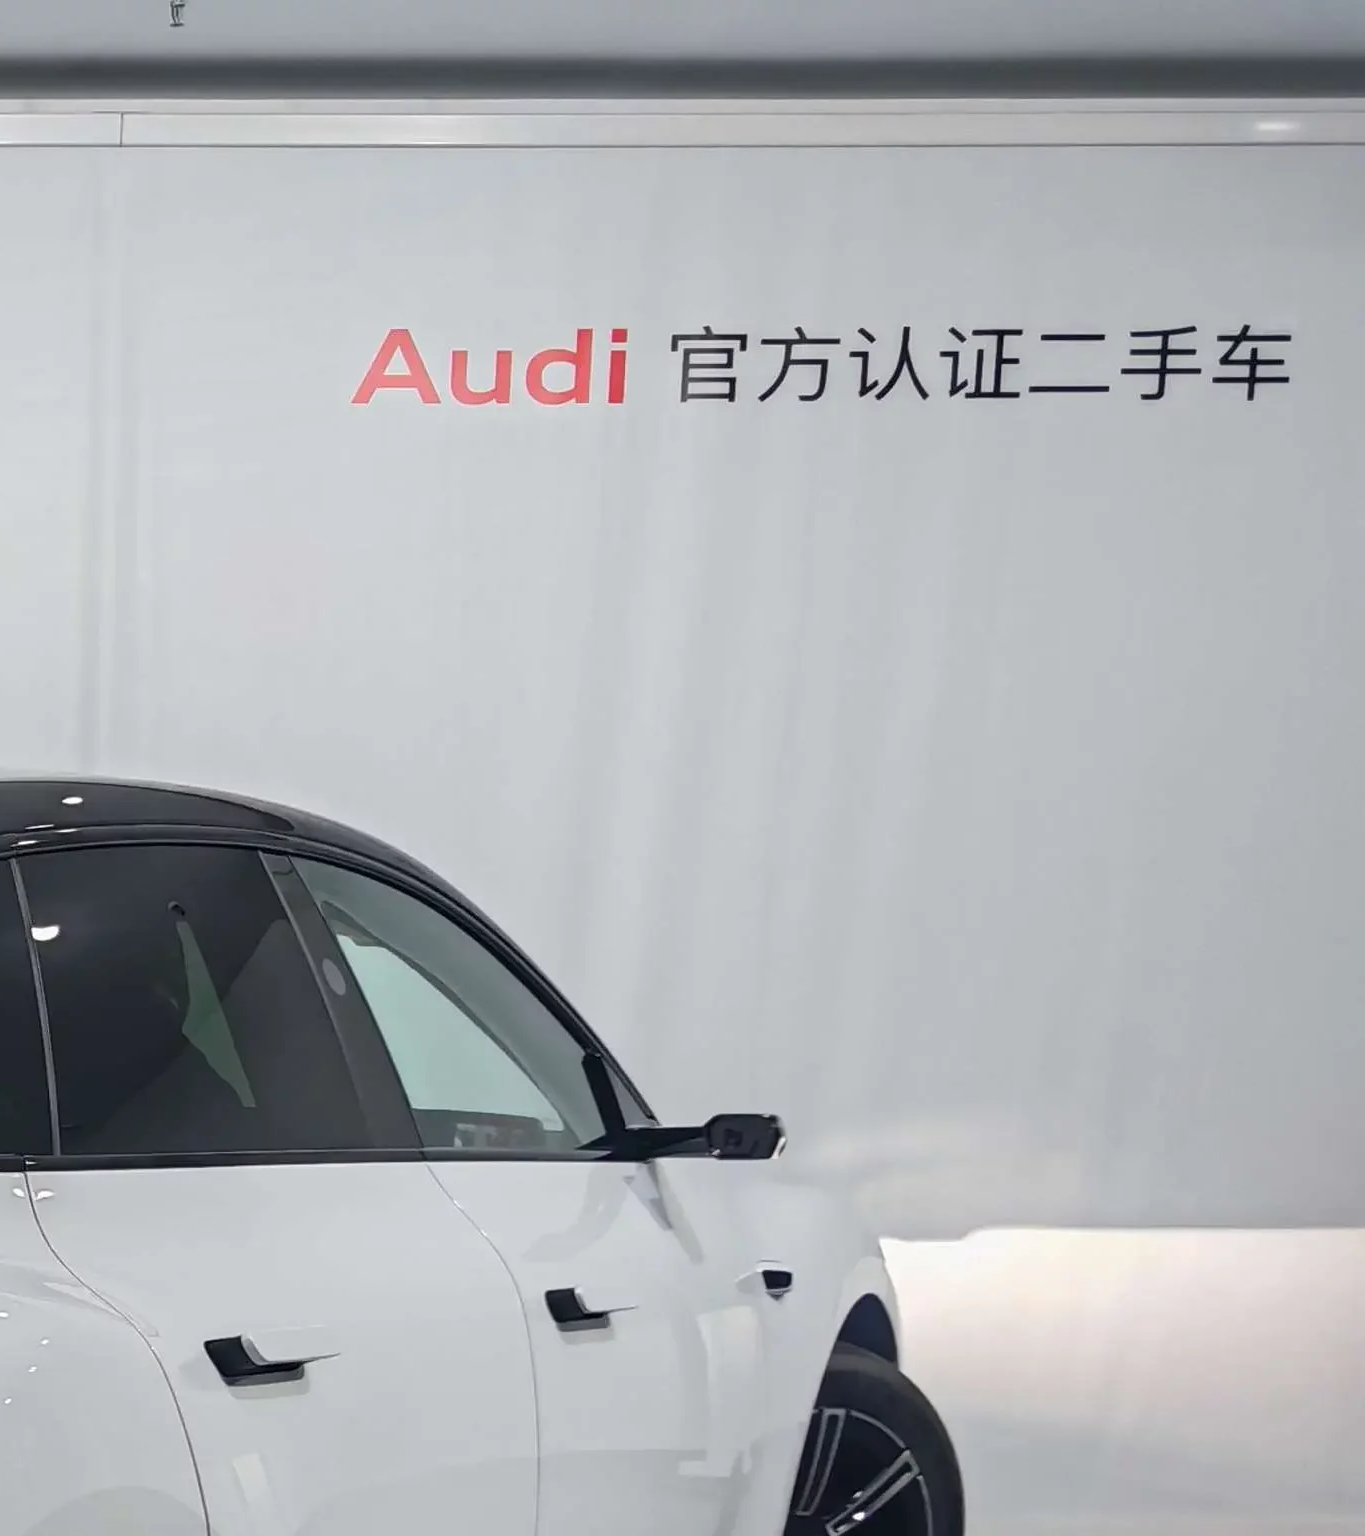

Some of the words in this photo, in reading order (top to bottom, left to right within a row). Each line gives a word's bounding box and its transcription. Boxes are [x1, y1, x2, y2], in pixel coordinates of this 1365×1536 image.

[351, 327, 630, 406] Audi
[670, 323, 1294, 404] 官方认证二手车
